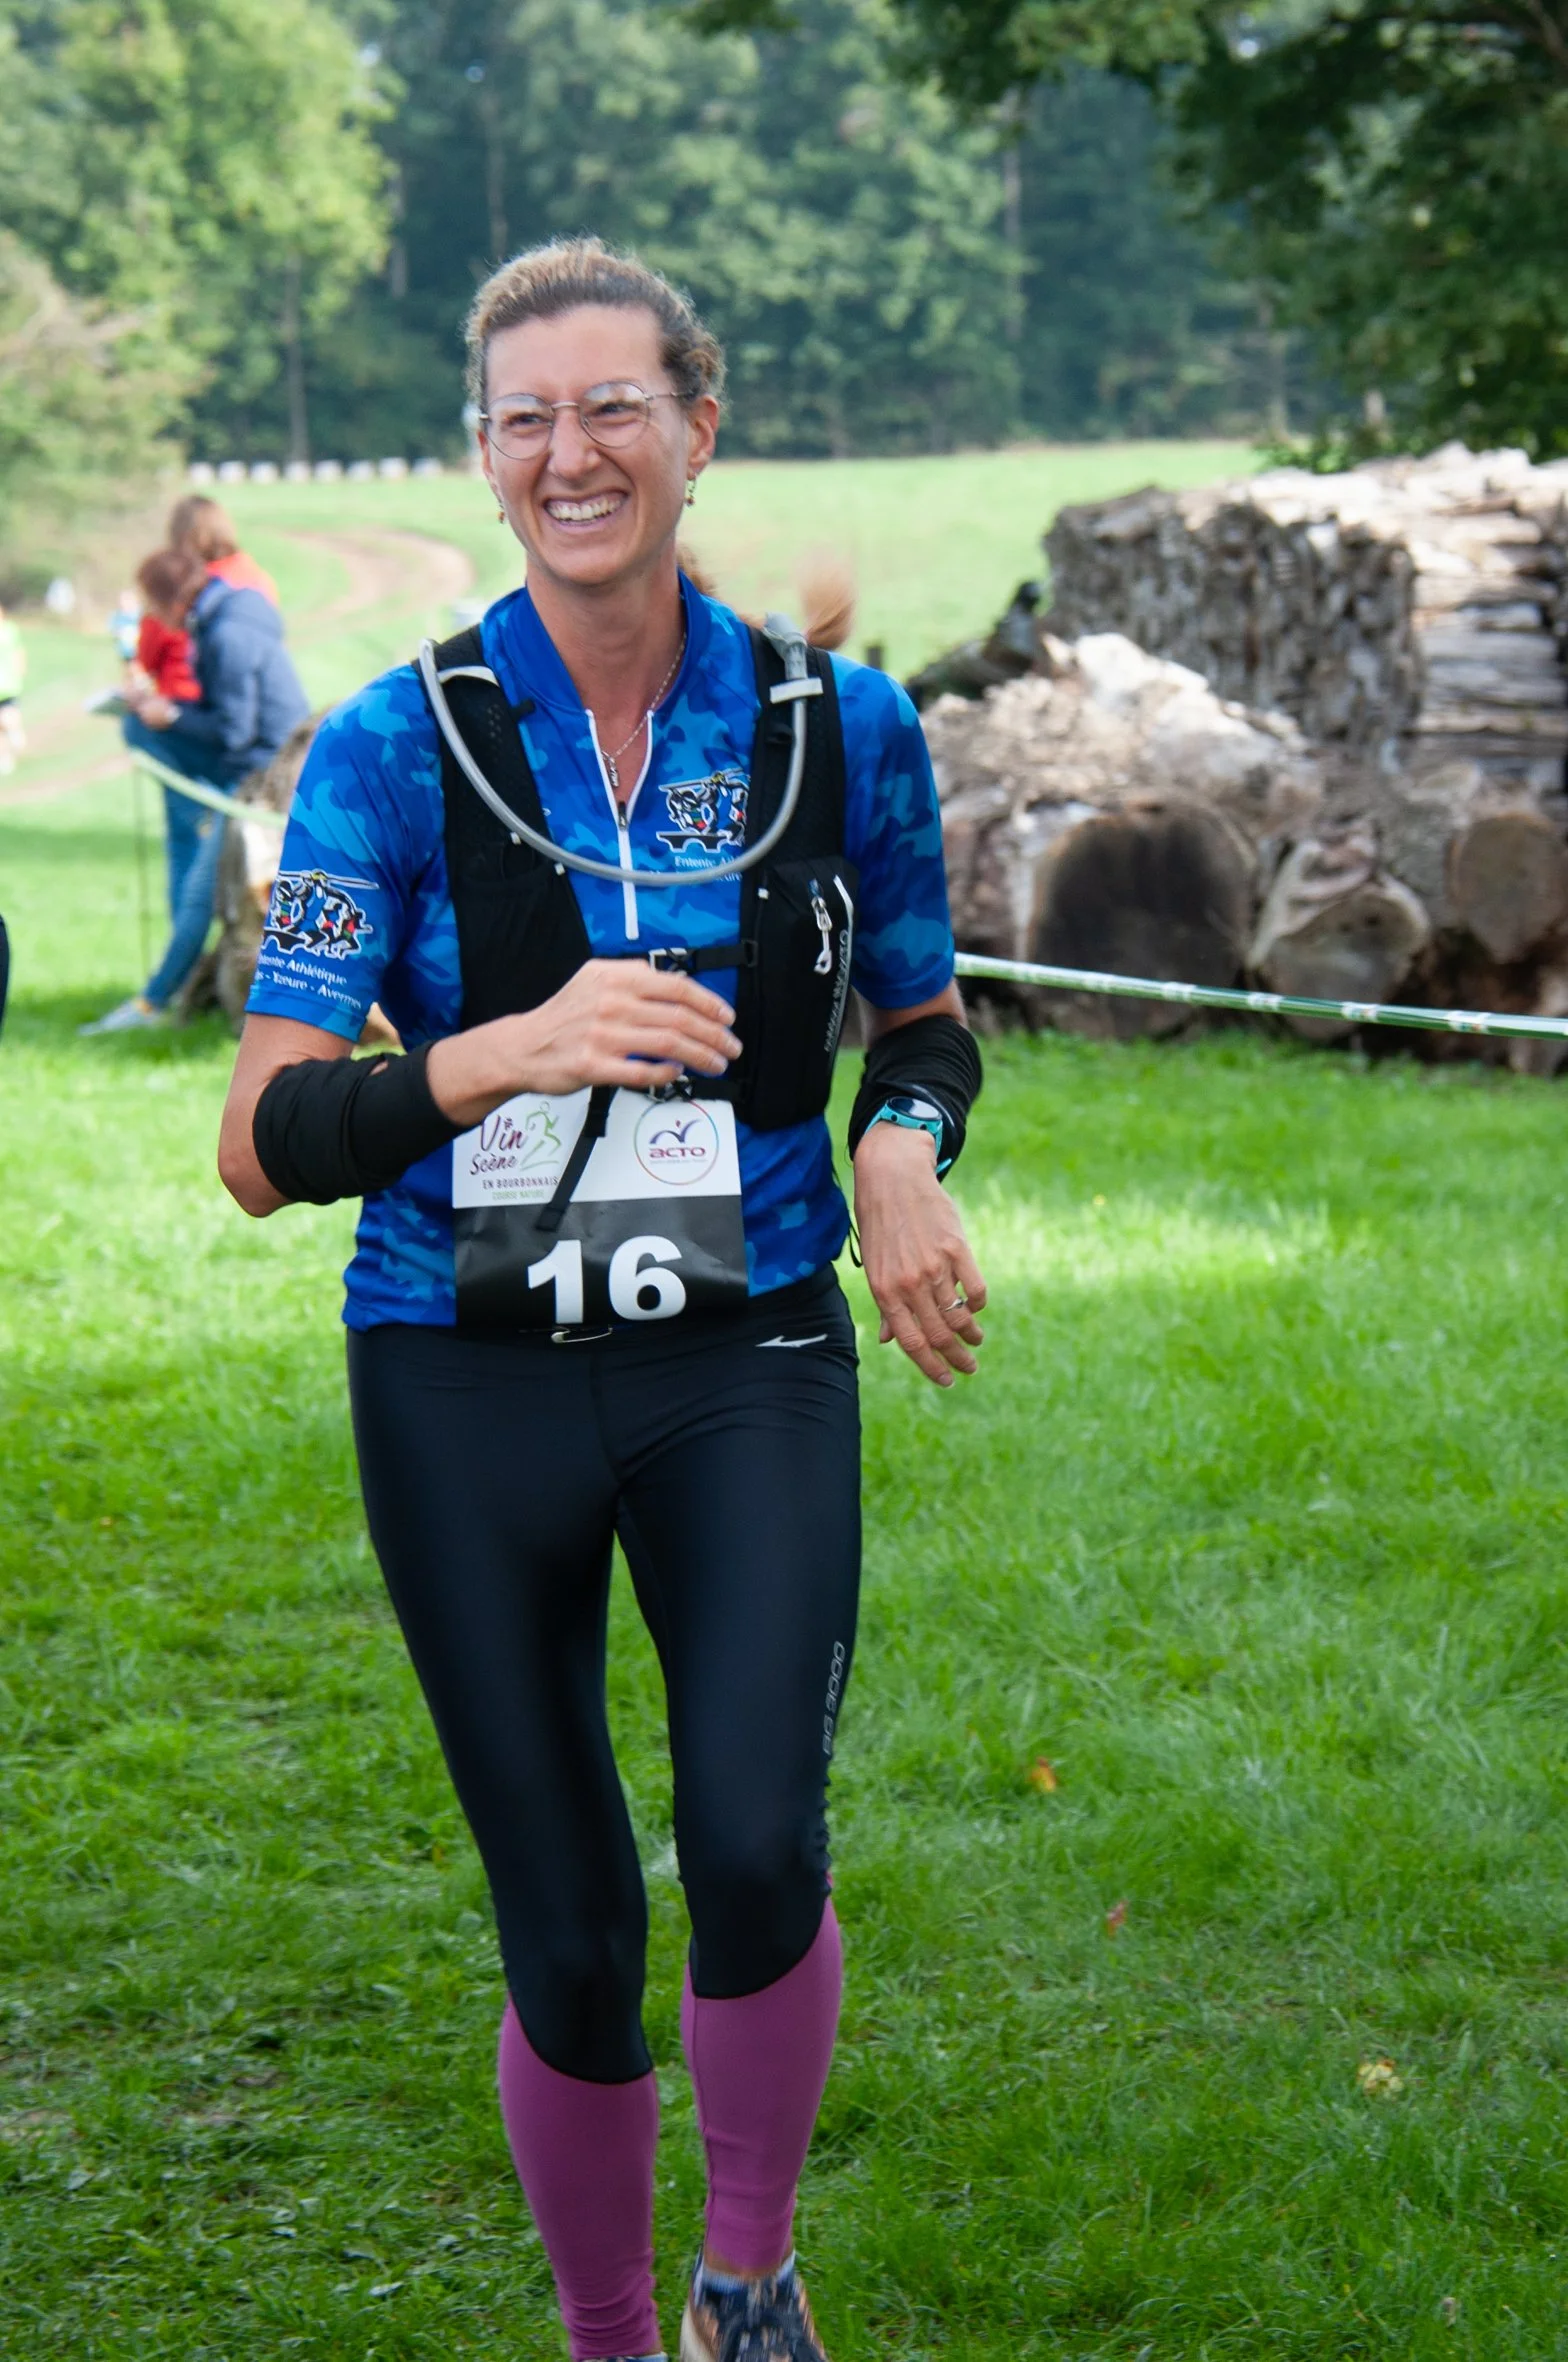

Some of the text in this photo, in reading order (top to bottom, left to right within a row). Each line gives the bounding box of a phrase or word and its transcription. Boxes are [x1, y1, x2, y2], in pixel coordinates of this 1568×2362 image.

[481, 1115, 528, 1151] Vin
[470, 1153, 517, 1175] Scène
[482, 1179, 494, 1190] EN
[527, 1235, 687, 1324] 16
